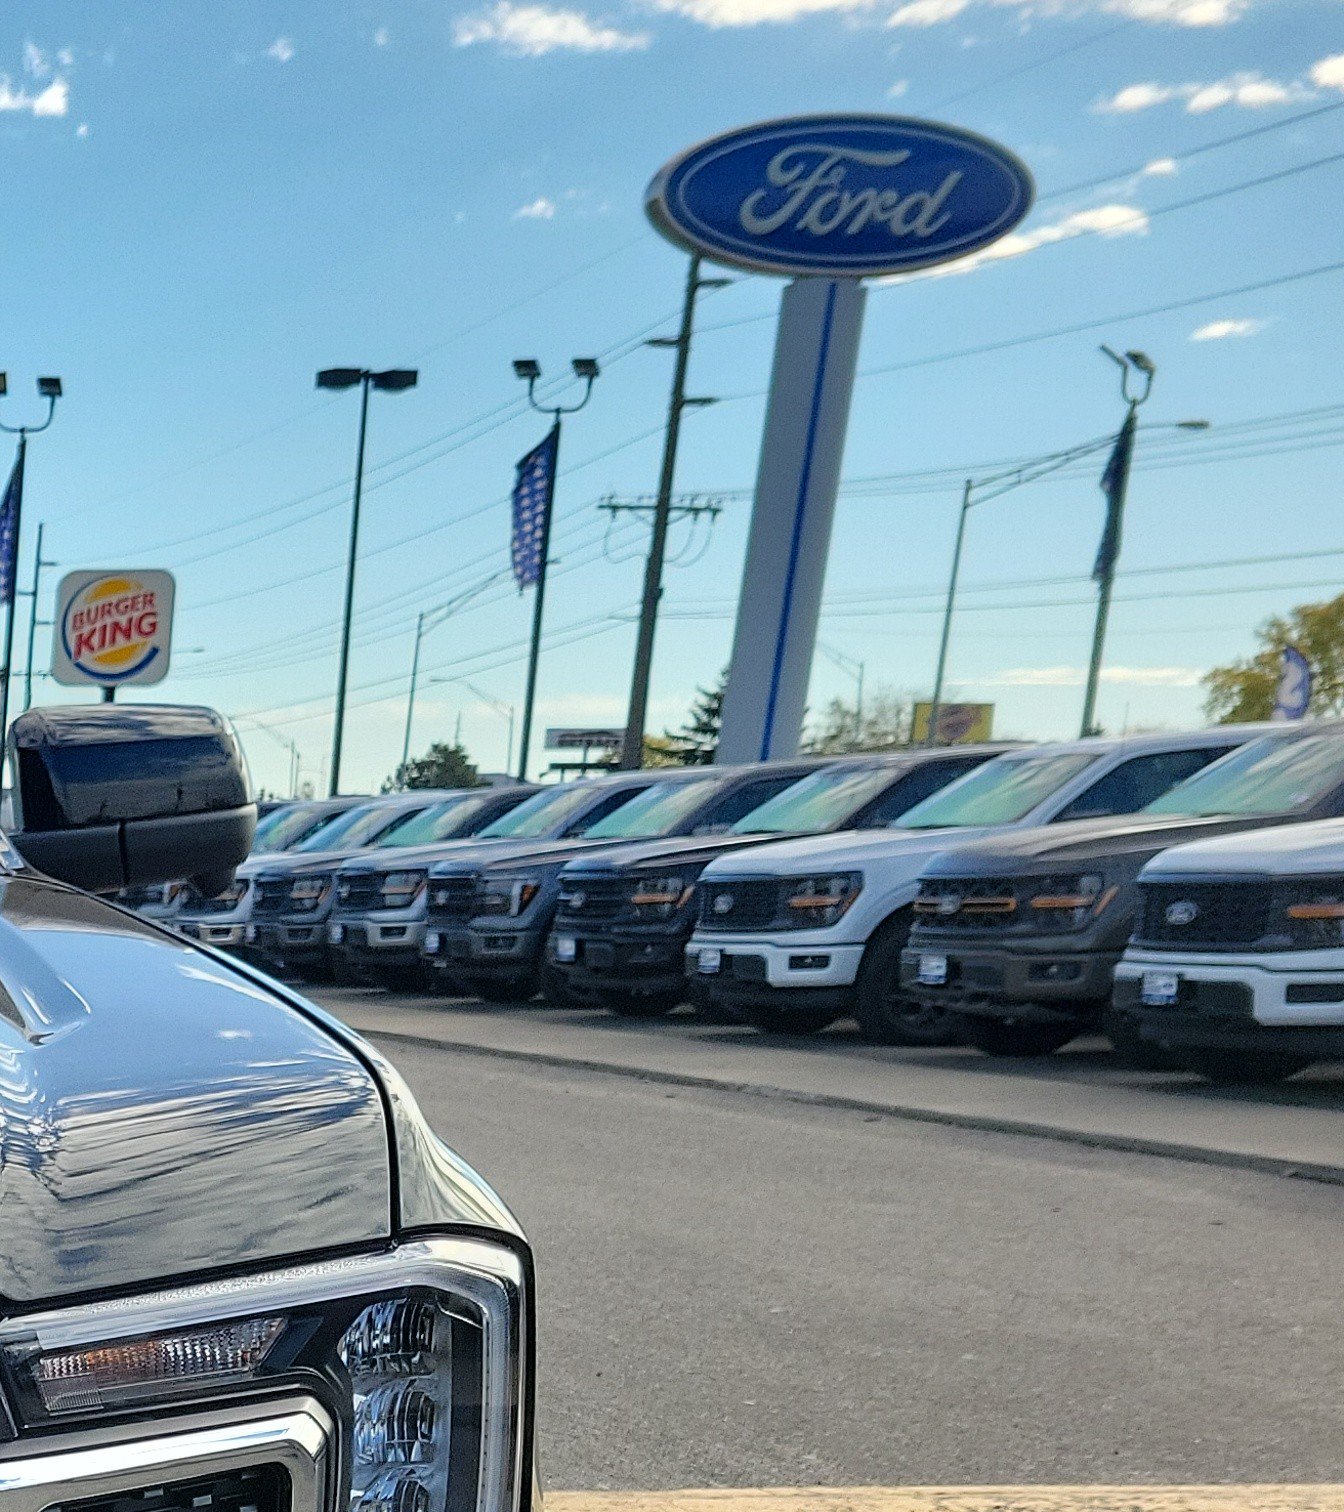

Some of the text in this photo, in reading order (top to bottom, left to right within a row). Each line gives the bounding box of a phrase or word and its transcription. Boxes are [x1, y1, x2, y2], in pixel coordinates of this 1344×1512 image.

[739, 143, 964, 238] Ford
[72, 591, 156, 631] BURGER
[73, 611, 159, 662] KING
